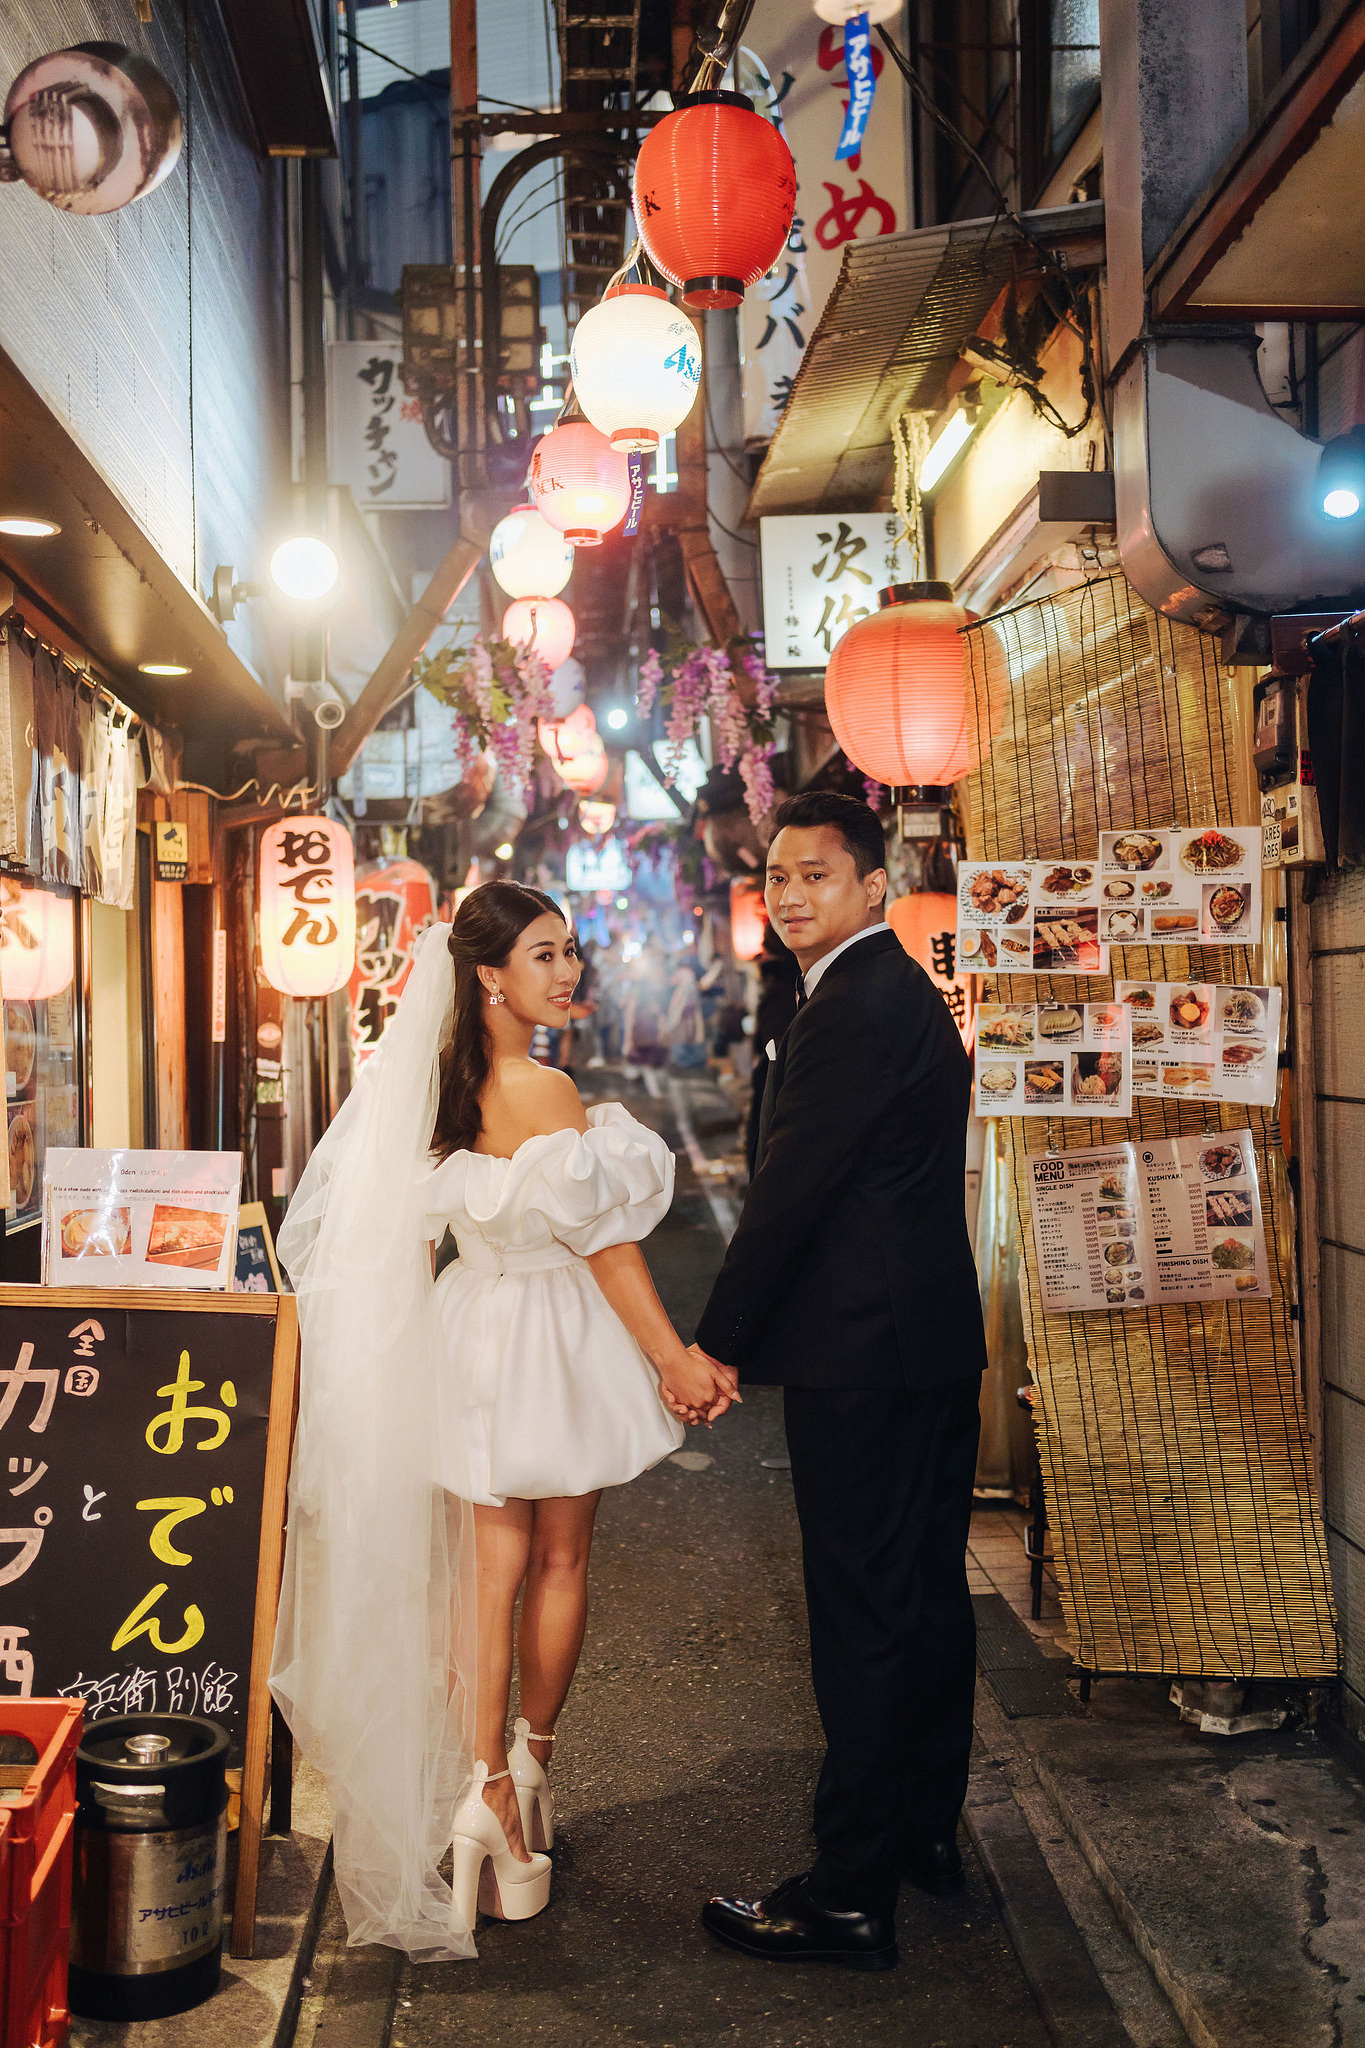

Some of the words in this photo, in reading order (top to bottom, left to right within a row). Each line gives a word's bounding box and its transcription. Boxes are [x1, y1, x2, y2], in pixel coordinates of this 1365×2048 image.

[841, 34, 872, 148] アサヒビール
[625, 464, 644, 530] アサヒビール
[1265, 825, 1280, 841] ARES
[162, 850, 183, 858] CCTV
[1263, 843, 1279, 859] ARES
[276, 830, 338, 946] おでん
[1033, 1161, 1064, 1172] FOOD
[1034, 1171, 1064, 1182] MENU
[1147, 1174, 1183, 1182] KUSHIYAKI
[1036, 1184, 1057, 1192] SINGLE
[1157, 1259, 1190, 1268] FINISHING
[64, 1318, 106, 1397] 全国
[82, 1484, 107, 1521] と
[111, 1349, 238, 1653] おでん
